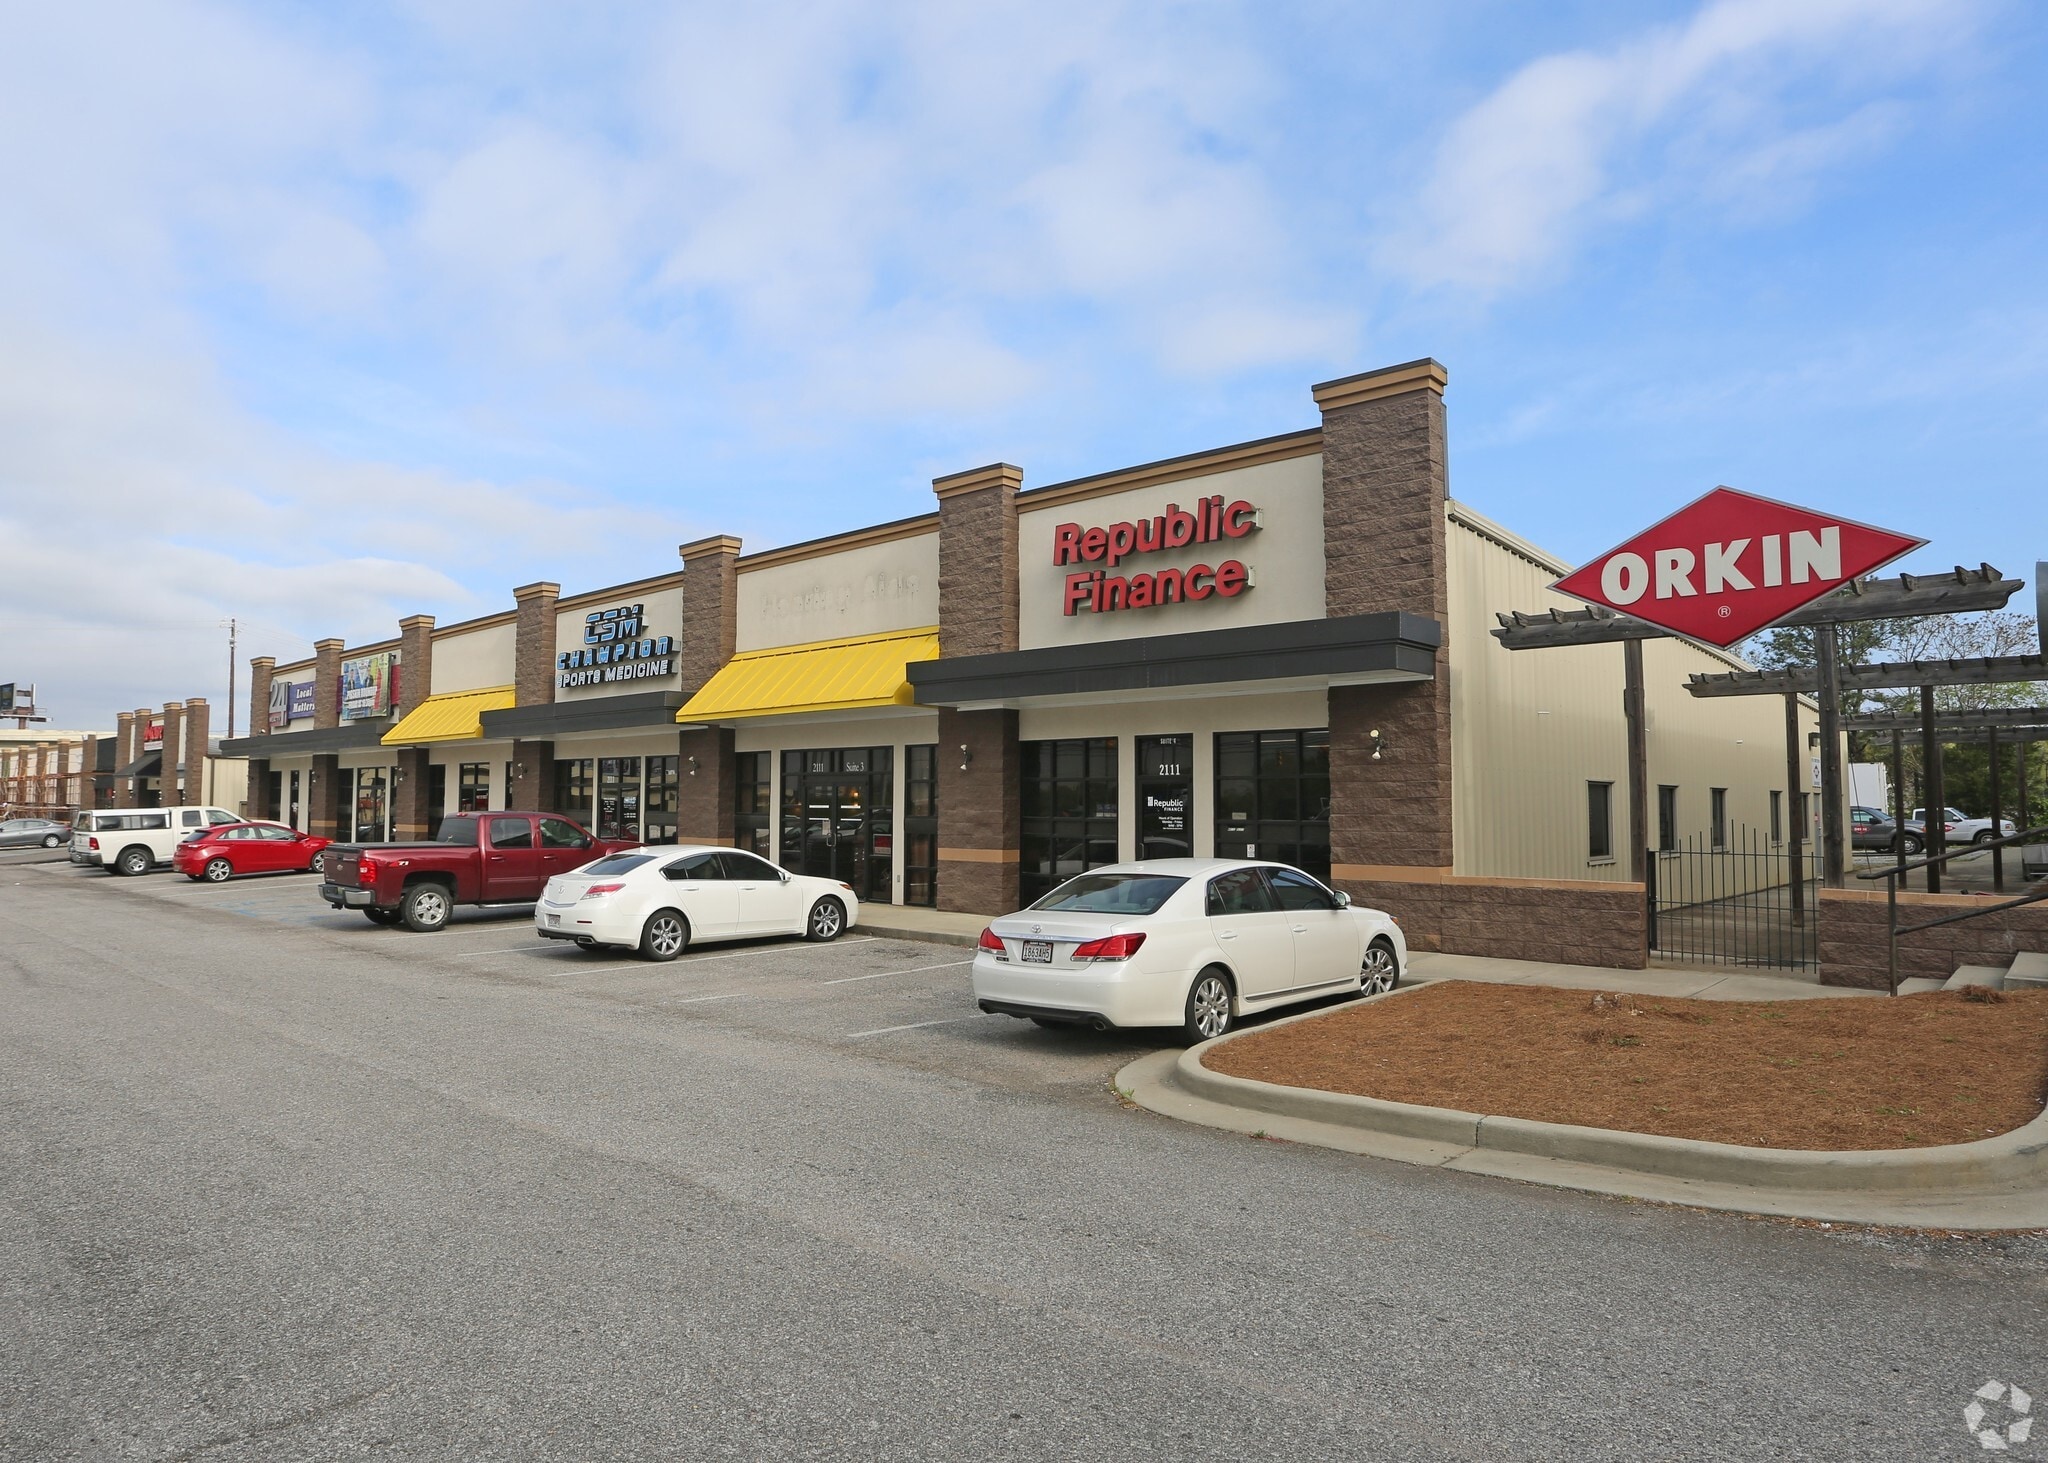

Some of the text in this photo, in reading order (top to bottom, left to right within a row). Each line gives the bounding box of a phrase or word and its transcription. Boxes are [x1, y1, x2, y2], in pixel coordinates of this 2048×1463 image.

[1053, 495, 1257, 567] Republic
[1601, 525, 1842, 606] ORKIN
[1064, 559, 1249, 617] Finance
[584, 604, 644, 645] CSM
[556, 636, 673, 671] CHAMPION
[605, 659, 672, 682] MEDICINE
[296, 686, 313, 699] Local
[292, 702, 315, 713] Matters
[846, 761, 860, 772] Suite
[1159, 763, 1180, 776] 2111
[1153, 798, 1184, 808] Republic
